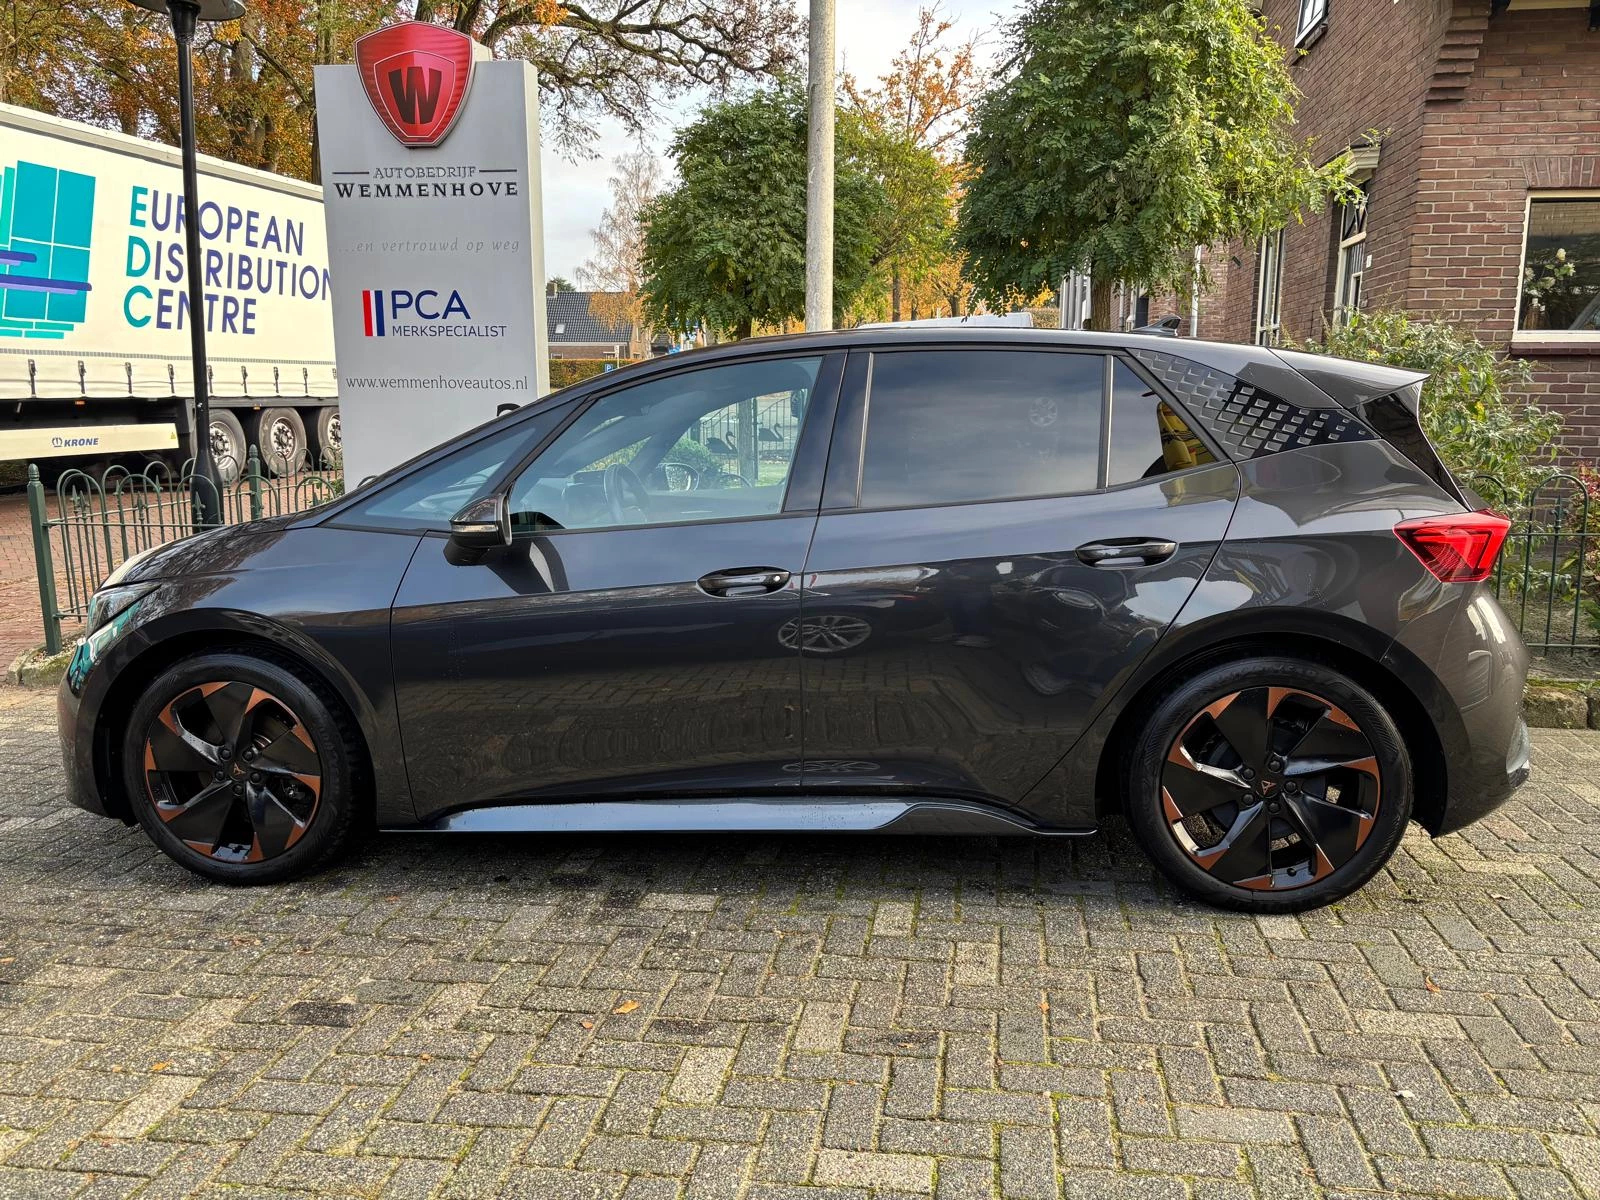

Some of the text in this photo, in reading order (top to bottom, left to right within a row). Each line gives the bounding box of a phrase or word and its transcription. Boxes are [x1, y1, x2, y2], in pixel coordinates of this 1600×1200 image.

[388, 66, 442, 125] W
[372, 166, 477, 180] AUTOBEDRIJF
[332, 181, 519, 198] WEMMENHOVE
[381, 237, 459, 252] vertrouwd
[466, 240, 485, 253] op
[491, 240, 520, 253] weg
[125, 235, 332, 301] DISRIBUTION
[123, 285, 257, 335] CENTRE
[390, 289, 472, 320] PCA
[392, 325, 508, 338] MERKSPECIALIST
[345, 374, 529, 391] www.wemmenhoveautos.nl
[64, 437, 100, 448] KRONE
